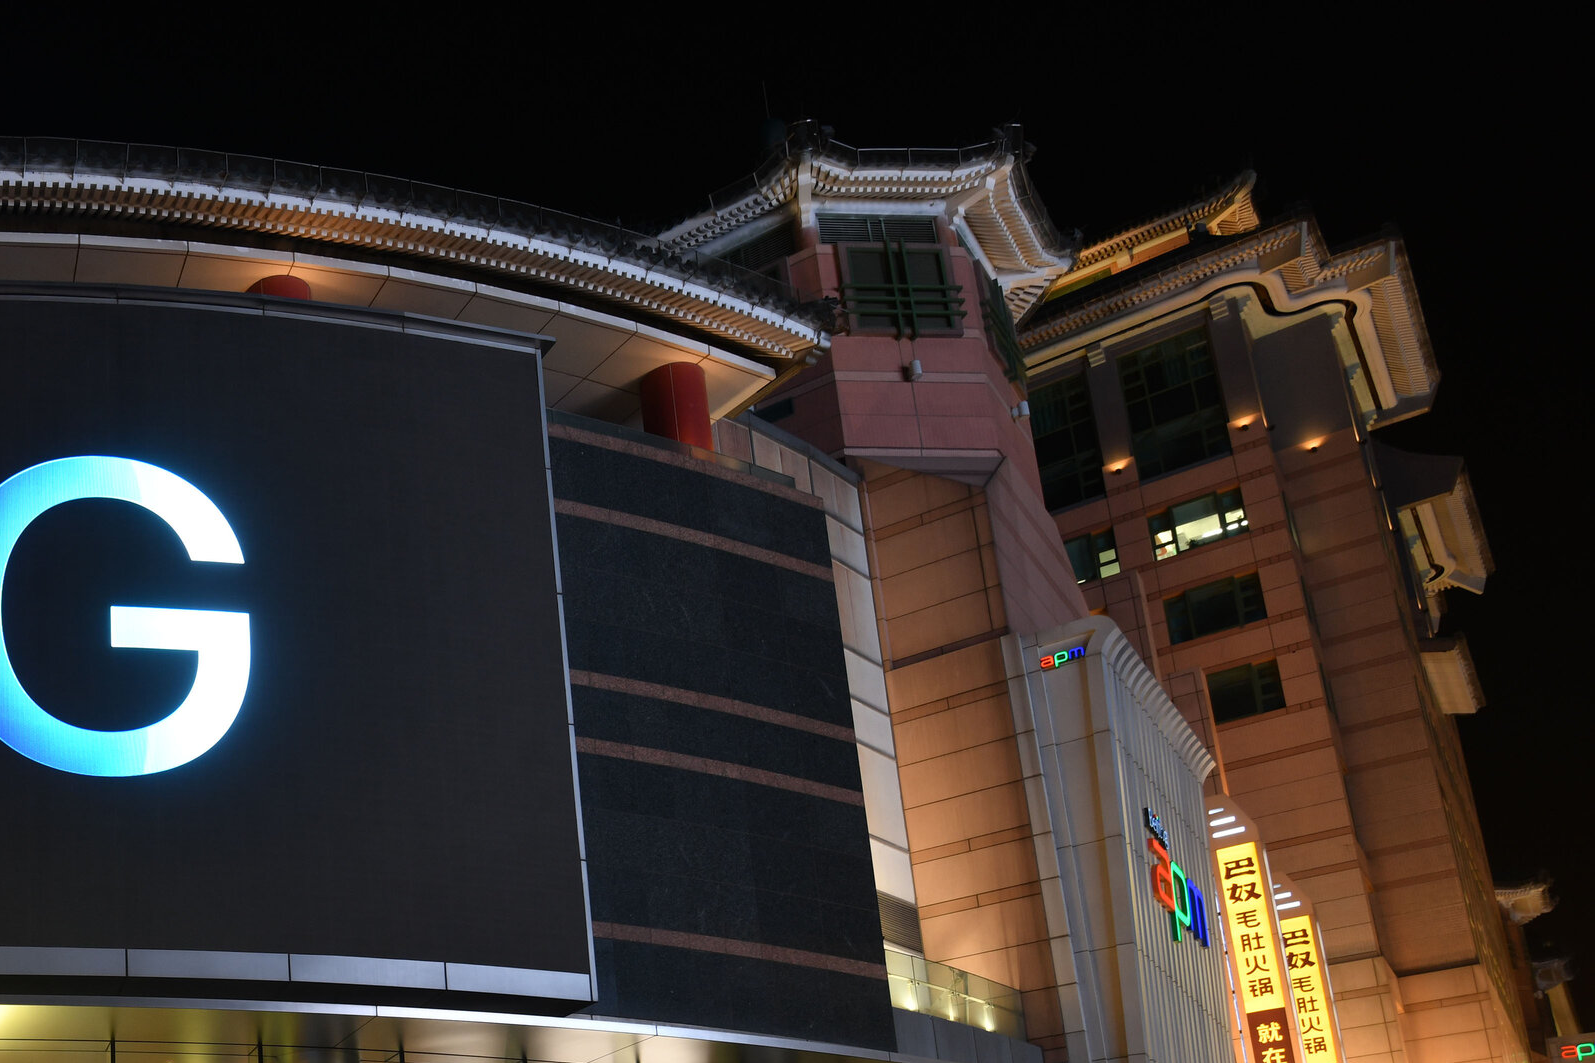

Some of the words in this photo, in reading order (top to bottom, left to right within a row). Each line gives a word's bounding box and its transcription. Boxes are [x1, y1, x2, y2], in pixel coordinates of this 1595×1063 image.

[1039, 646, 1085, 668] apm
[1148, 837, 1210, 948] apm
[1224, 857, 1275, 998] 巴奴毛肚火锅
[1282, 928, 1328, 1055] 巴奴毛肚火锅
[1561, 1043, 1595, 1061] ap
